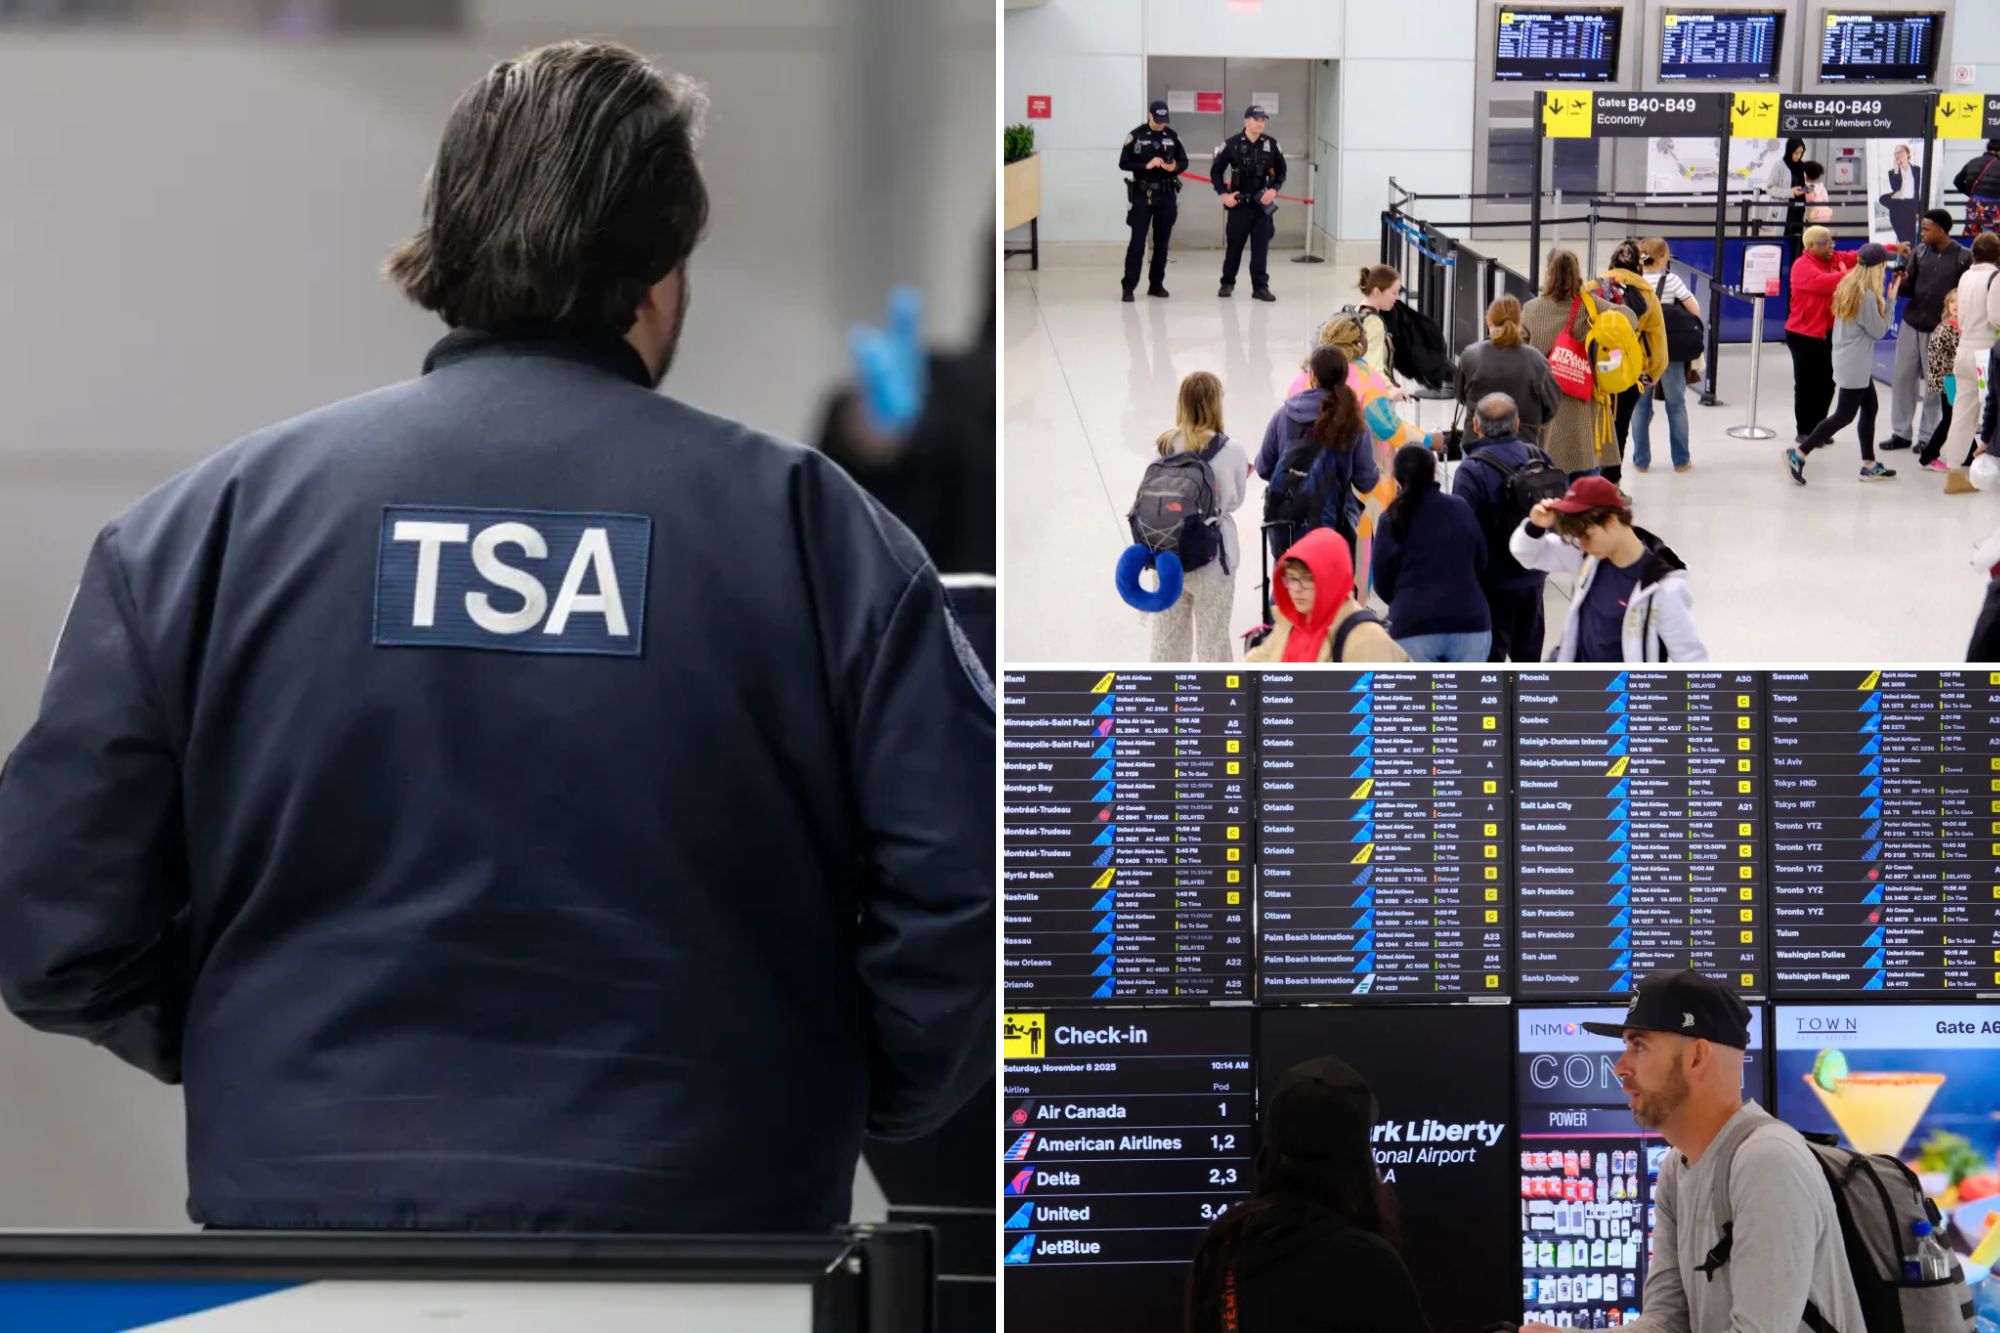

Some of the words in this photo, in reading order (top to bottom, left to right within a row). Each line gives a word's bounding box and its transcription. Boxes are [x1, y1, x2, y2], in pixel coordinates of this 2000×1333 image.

[1597, 97, 1627, 108] Gates
[1628, 97, 1696, 113] B40-B49
[1784, 99, 1814, 110] Gates
[1814, 100, 1882, 114] B40-B49
[1597, 113, 1646, 127] Economy
[1802, 119, 1831, 127] CLEAR
[1834, 118, 1872, 128] Members
[1872, 118, 1892, 129] Only
[393, 520, 630, 636] TSA
[1262, 674, 1294, 683] Orlando
[1480, 675, 1498, 683] A34
[1518, 673, 1550, 681] Phoenix
[1772, 672, 1809, 681] Savannah
[1262, 695, 1294, 704] Orlando
[1480, 696, 1498, 705] A26
[1519, 694, 1559, 704] Pittsburgh
[1772, 693, 1798, 703] Tampa
[1072, 718, 1091, 727] Paul
[1227, 719, 1239, 728] A5
[1262, 717, 1294, 725] Orlando
[1519, 716, 1550, 724] Quebec
[1772, 715, 1798, 725] Tampa
[1072, 740, 1091, 749] Paul
[1262, 738, 1295, 747] Orlando
[1482, 739, 1497, 747] A17
[1519, 737, 1581, 747] Raleigh-Durham
[1773, 736, 1798, 746] Tampa
[1262, 760, 1295, 769] Orlando
[1519, 758, 1581, 768] Raleigh-Durham
[1773, 757, 1786, 766] Tel
[1786, 757, 1803, 766] Aviv
[1037, 761, 1054, 772] Bay
[1037, 783, 1054, 793] Bay
[1225, 784, 1241, 793] A12
[1262, 781, 1295, 790] Orlando
[1519, 780, 1559, 789] Richmond
[1773, 779, 1797, 789] Tokyo
[1263, 803, 1295, 812] Orlando
[1520, 801, 1537, 810] Salt
[1536, 801, 1556, 810] Lake
[1555, 801, 1573, 811] City
[1737, 803, 1753, 811] A21
[1774, 800, 1797, 810] Tokyo
[1227, 806, 1239, 814] A2
[1263, 825, 1295, 833] Orlando
[1520, 823, 1536, 831] San
[1536, 823, 1567, 831] Antonio
[1773, 821, 1804, 830] Toronto
[1806, 821, 1823, 830] YTZ
[1263, 846, 1295, 855] Orlando
[1520, 844, 1537, 853] San
[1536, 844, 1574, 853] Francisco
[1774, 843, 1804, 851] Toronto
[1806, 843, 1823, 851] YTZ
[1263, 868, 1292, 877] Ottawa
[1520, 866, 1537, 874] San
[1536, 866, 1575, 874] Francisco
[1774, 864, 1804, 873] Toronto
[1806, 864, 1824, 873] YYZ
[1029, 871, 1054, 880] Beach
[1263, 890, 1292, 898] Ottawa
[1520, 887, 1537, 896] San
[1536, 887, 1575, 896] Francisco
[1775, 886, 1805, 894] Toronto
[1807, 886, 1824, 894] YYZ
[1263, 911, 1292, 920] Ottawa
[1520, 909, 1537, 917] San
[1537, 909, 1575, 917] Francisco
[1775, 907, 1805, 916] Toronto
[1807, 907, 1824, 916] YYZ
[1483, 932, 1501, 941] A23
[1521, 930, 1537, 939] San
[1537, 930, 1575, 939] Francisco
[1775, 928, 1800, 937] Tulum
[1264, 933, 1284, 942] Palm
[1284, 933, 1310, 942] Beach
[1264, 955, 1284, 964] Palm
[1284, 955, 1310, 963] Beach
[1484, 954, 1500, 963] A14
[1521, 952, 1537, 961] San
[1537, 952, 1557, 961] Juan
[1739, 953, 1755, 961] A31
[1776, 950, 1821, 960] Washington
[1821, 950, 1846, 959] Dulles
[1021, 958, 1052, 967] Orleans
[1225, 958, 1242, 966] A22
[1264, 977, 1284, 985] Palm
[1284, 977, 1310, 985] Beach
[1521, 974, 1545, 982] Santo
[1545, 974, 1580, 984] Domingo
[1776, 972, 1821, 982] Washington
[1821, 972, 1851, 982] Reagan
[1225, 979, 1242, 988] A25
[1795, 1017, 1857, 1031] TOWN
[1935, 1020, 1976, 1035] Gate
[1054, 1024, 1148, 1045] Check-in
[1004, 1064, 1042, 1074] Saturday,
[1042, 1063, 1086, 1072] November
[1085, 1063, 1093, 1072] 8
[1093, 1062, 1117, 1072] 2025
[1211, 1061, 1234, 1070] 10:14
[1234, 1061, 1249, 1070] AM
[1004, 1086, 1030, 1094] Airline
[1213, 1082, 1230, 1091] Pod
[1036, 1104, 1062, 1120] Air
[1064, 1103, 1127, 1120] Canada
[1218, 1102, 1227, 1117] 1
[1549, 1111, 1588, 1127] POWER
[1405, 1119, 1505, 1147] Liberty
[1036, 1136, 1115, 1152] American
[1118, 1135, 1183, 1151] Airlines
[1210, 1134, 1235, 1152] 1,2
[1415, 1146, 1477, 1167] Airport
[1036, 1171, 1081, 1187] Delta
[1209, 1168, 1238, 1186] 2,3
[1382, 1168, 1396, 1184] A
[1036, 1206, 1090, 1222] United
[1036, 1239, 1101, 1256] JetBlue
